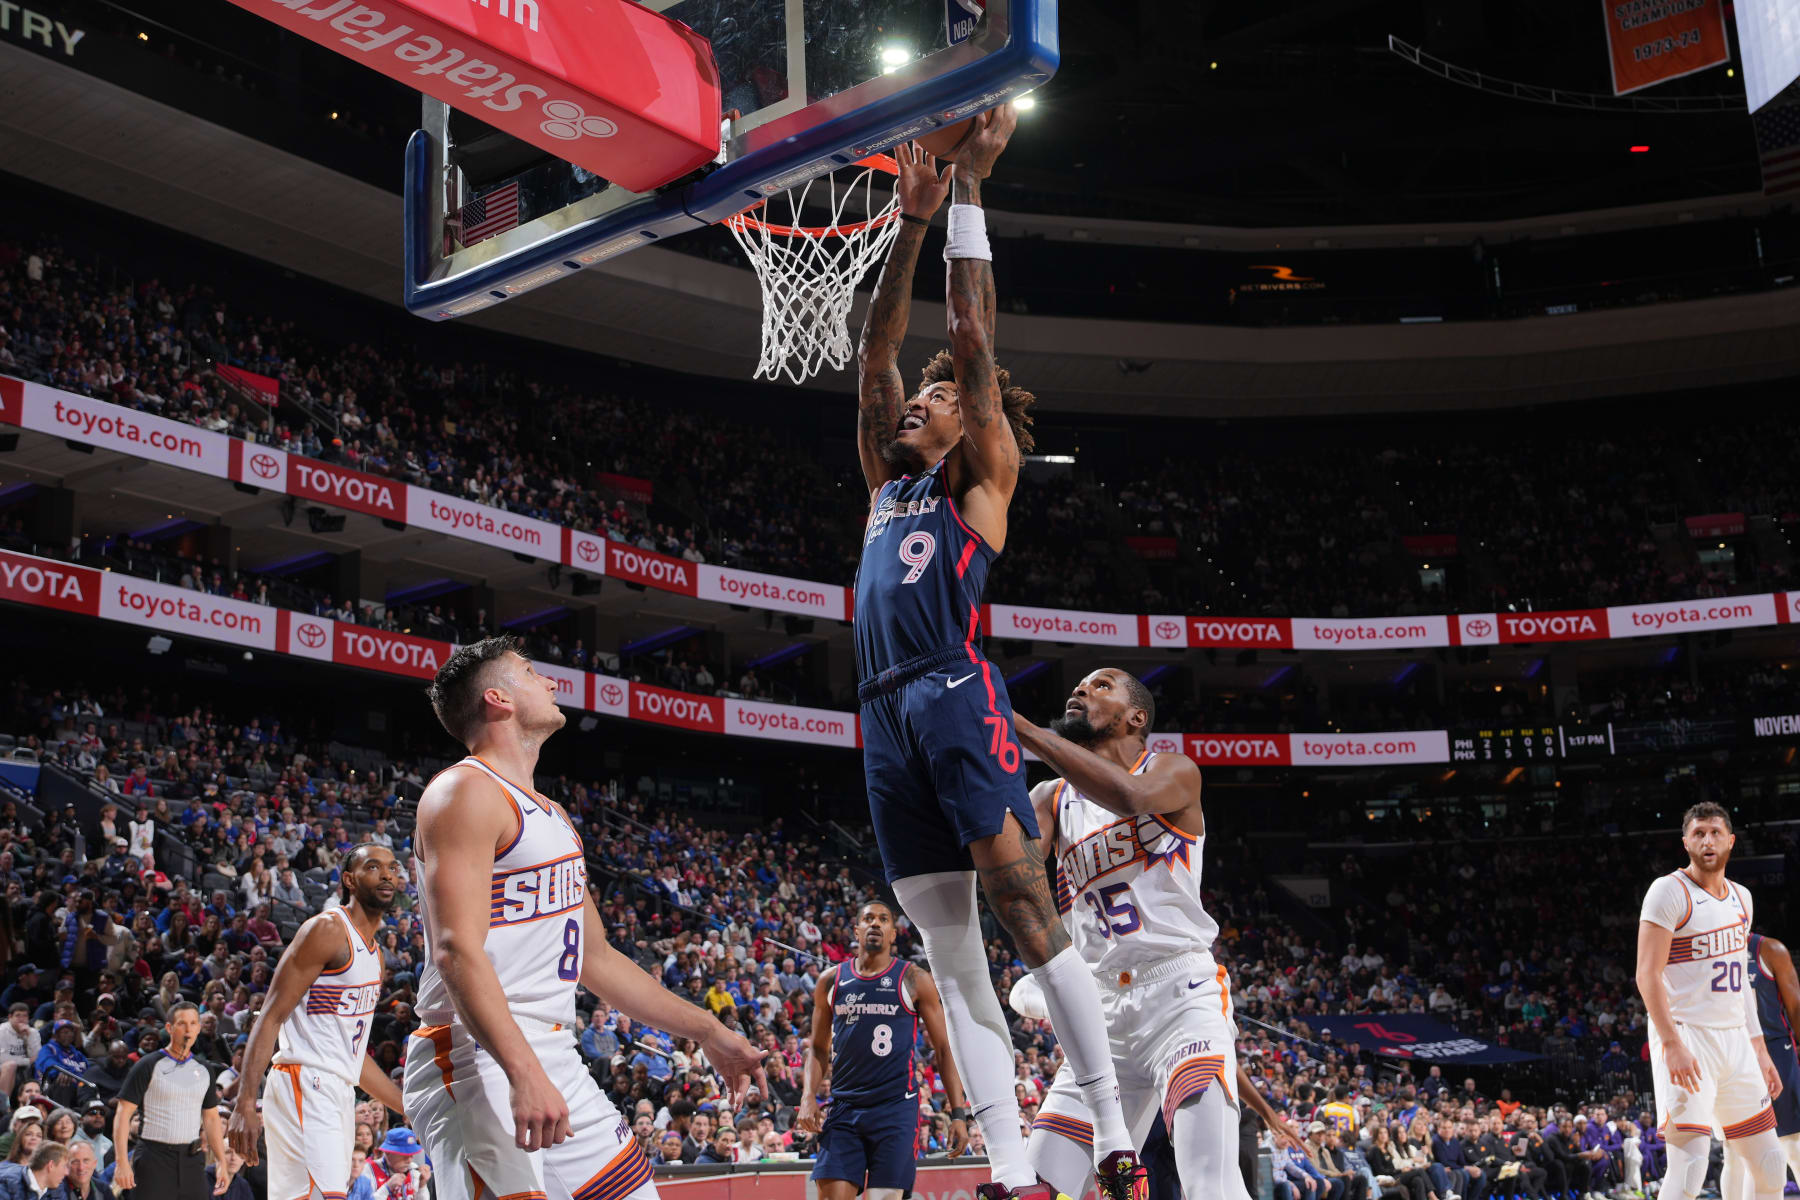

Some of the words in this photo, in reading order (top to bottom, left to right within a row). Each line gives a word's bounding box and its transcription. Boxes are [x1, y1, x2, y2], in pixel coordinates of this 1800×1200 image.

[1633, 28, 1701, 62] 1973-74
[865, 125, 921, 151] POKERSTARS
[54, 400, 202, 458] toyota.com
[297, 464, 394, 510] TOYOTA
[430, 499, 542, 546] toyota.com
[612, 548, 688, 587] TOYOTA
[899, 531, 936, 584] 9
[719, 574, 826, 607] toyota.com
[118, 585, 262, 634] toyota.com
[1012, 613, 1118, 636] toyota.com
[1505, 616, 1597, 636] TOYOTA
[1632, 602, 1753, 629] toyota.com
[1194, 623, 1282, 641] TOYOTA
[1312, 624, 1427, 644] toyota.com
[342, 631, 438, 671] TOYOTA
[635, 690, 713, 723] TOYOTA
[738, 706, 845, 736] toyota.com
[984, 716, 1020, 774] 76
[1190, 739, 1280, 758] TOYOTA
[1303, 738, 1416, 760] toyota.com
[1454, 739, 1473, 750] PHI
[1484, 739, 1491, 748] 2
[1524, 738, 1532, 747] 0
[1544, 737, 1552, 746] 0
[1454, 750, 1476, 760] PHX
[1485, 750, 1492, 759] 3
[1505, 749, 1512, 759] 5
[1546, 747, 1554, 757] 0
[1587, 734, 1605, 745] PM
[1062, 822, 1136, 898] SUNS
[503, 857, 586, 922] SUNS
[1084, 881, 1143, 940] 35
[558, 918, 580, 982] 8
[1691, 923, 1746, 960] SUNS
[1711, 961, 1742, 992] 20
[834, 1003, 900, 1016] BROTHERLY
[871, 1023, 893, 1057] 8
[1414, 1043, 1489, 1059] STARS
[1165, 1039, 1212, 1079] PHOENIX
